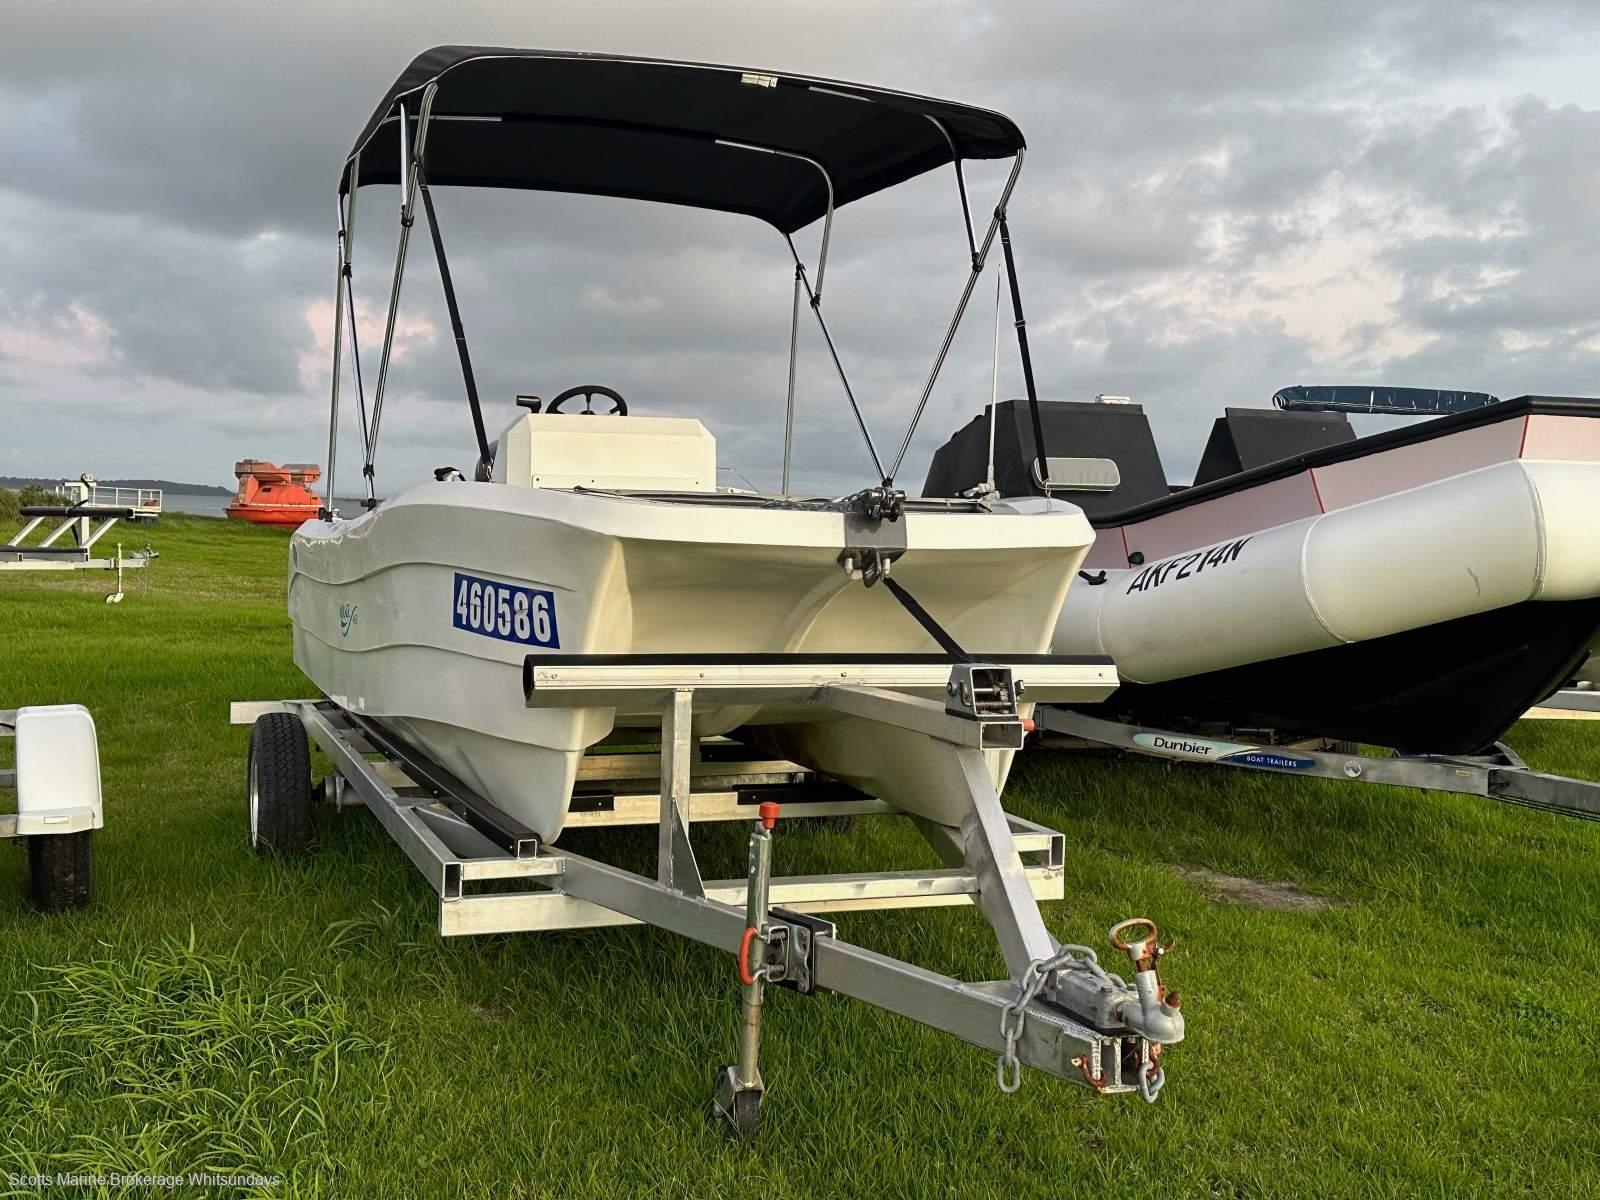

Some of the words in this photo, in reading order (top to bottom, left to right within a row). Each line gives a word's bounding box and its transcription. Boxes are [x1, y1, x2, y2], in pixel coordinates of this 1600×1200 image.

[1126, 536, 1253, 595] AKF214N
[456, 579, 551, 643] 460586
[1153, 736, 1212, 755] Dunbier
[1246, 755, 1264, 764] BOAT
[1267, 756, 1297, 768] TRAILERS
